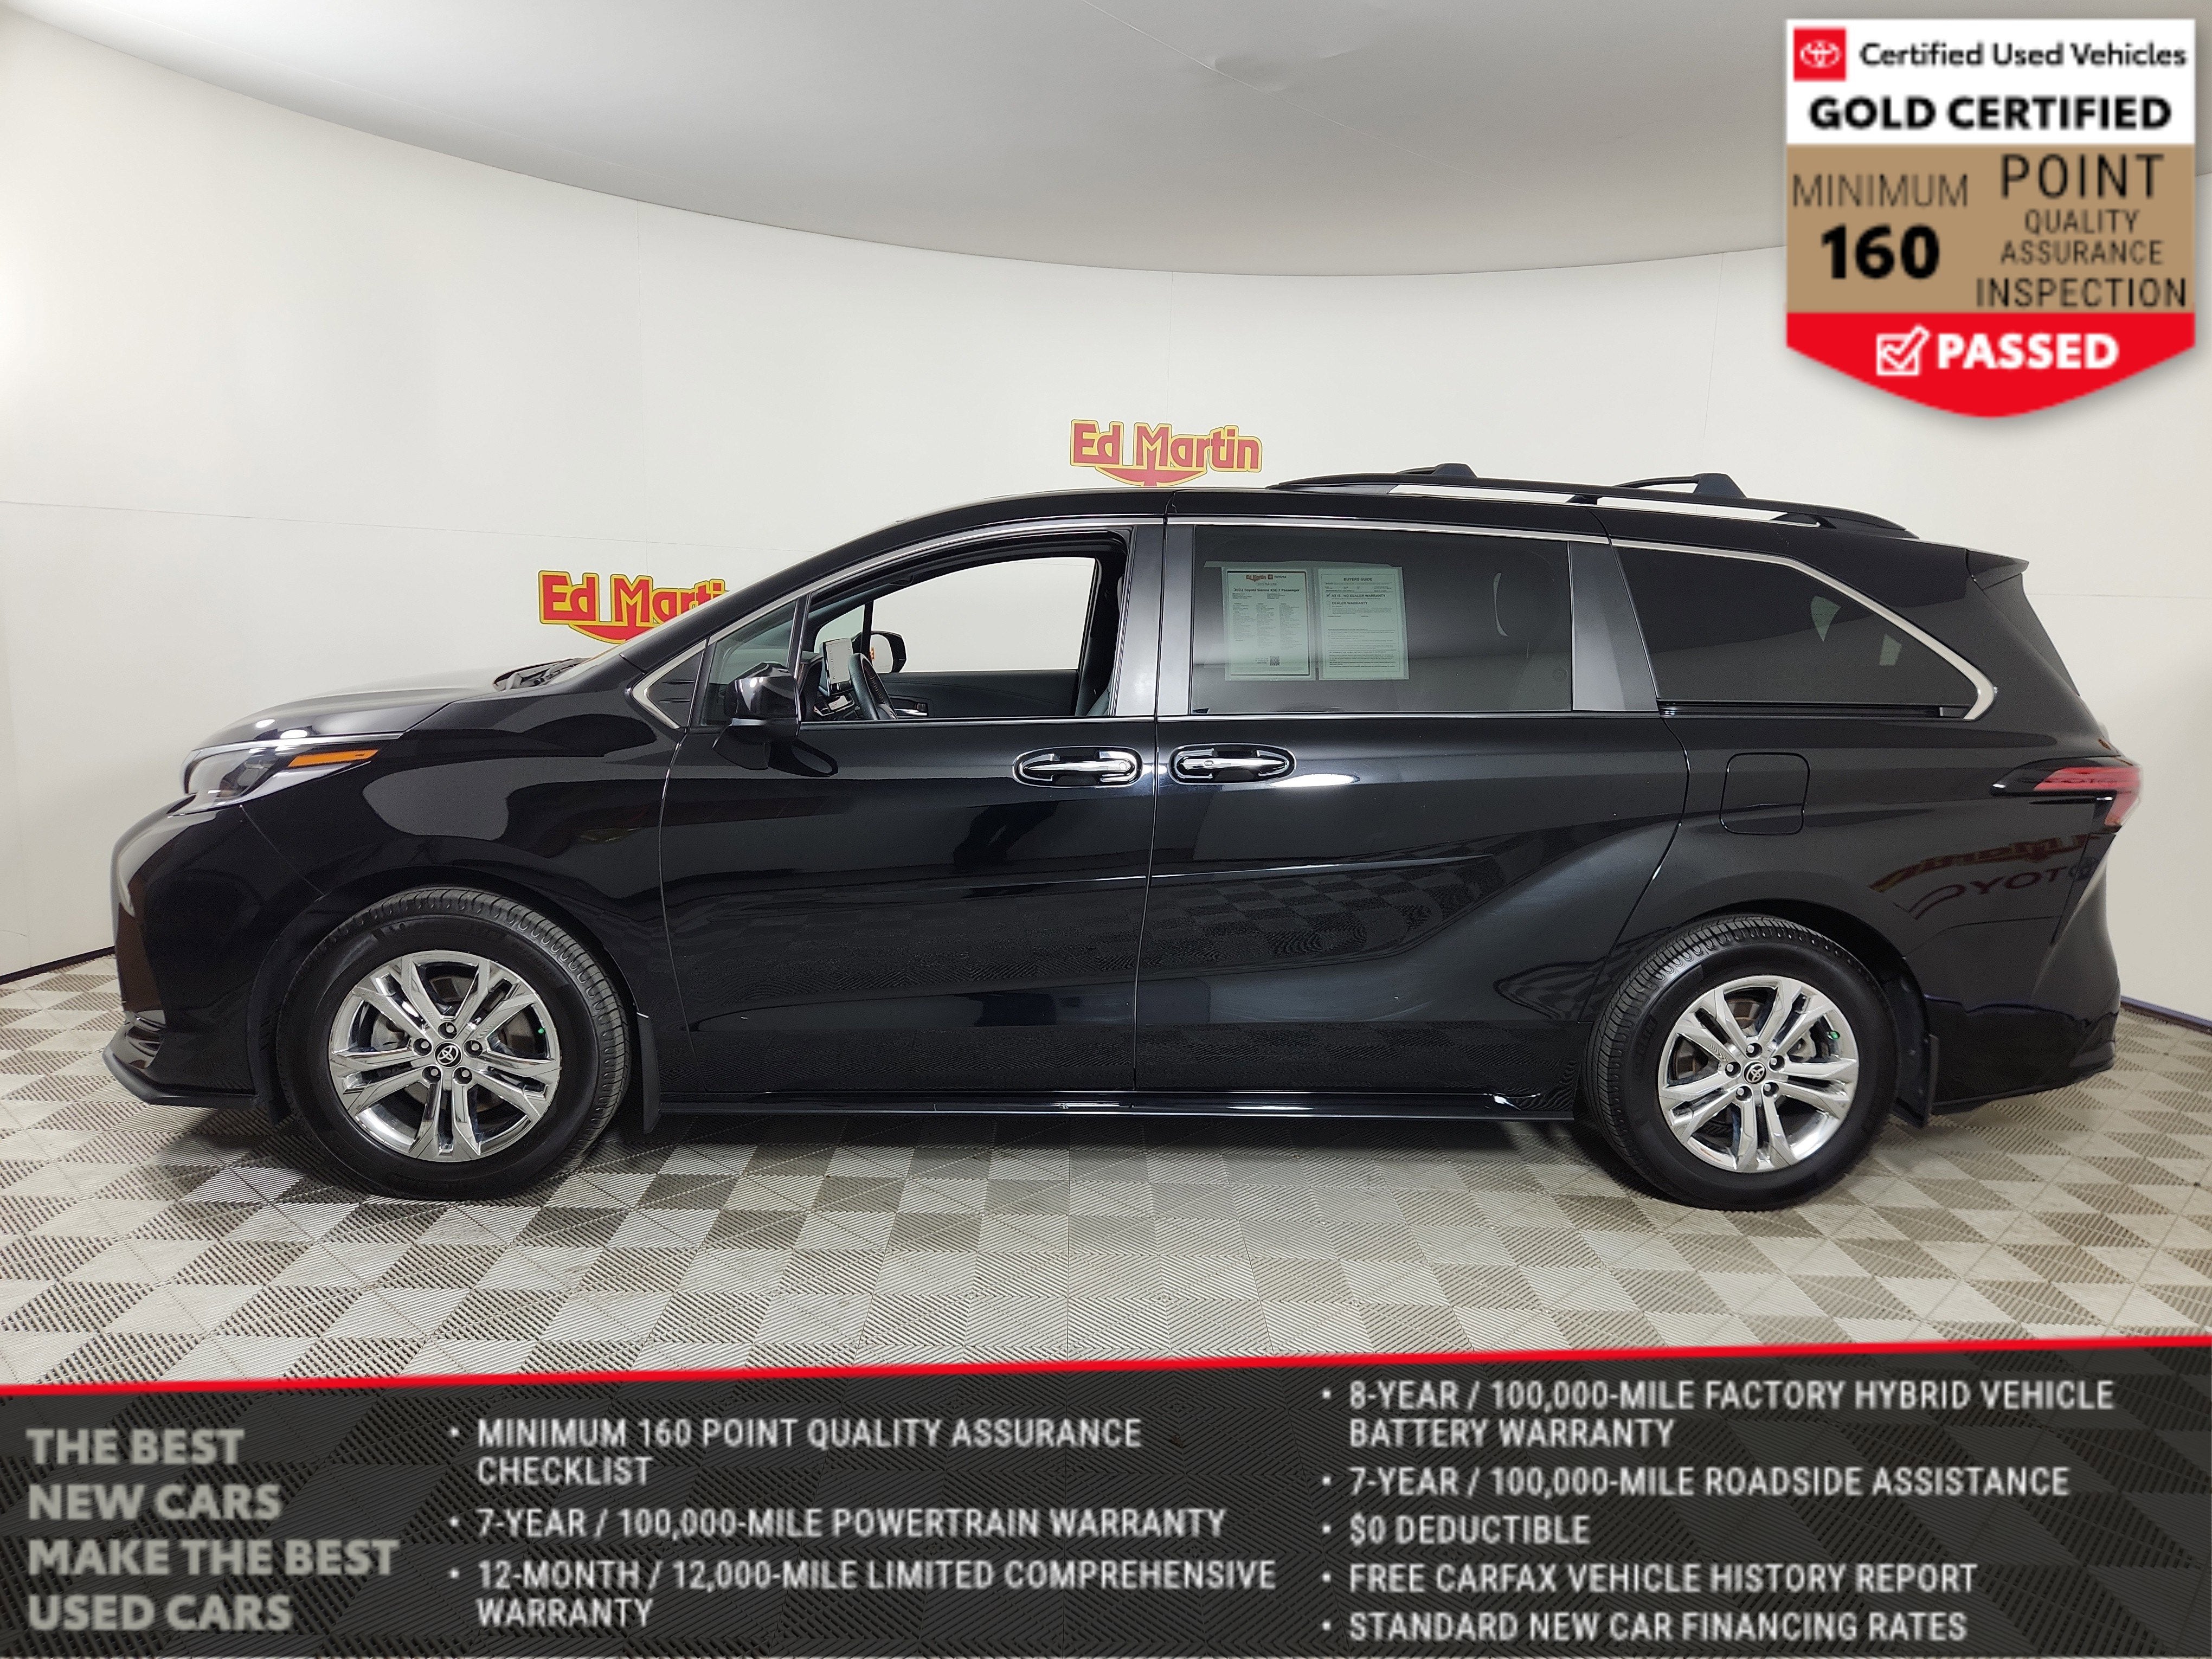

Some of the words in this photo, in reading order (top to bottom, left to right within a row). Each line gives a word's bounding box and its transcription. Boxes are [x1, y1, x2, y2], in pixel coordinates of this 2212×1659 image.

[1070, 419, 1123, 466] Ed
[1134, 422, 1263, 473] Martin
[538, 570, 599, 624] Ed
[610, 574, 729, 626] Mart
